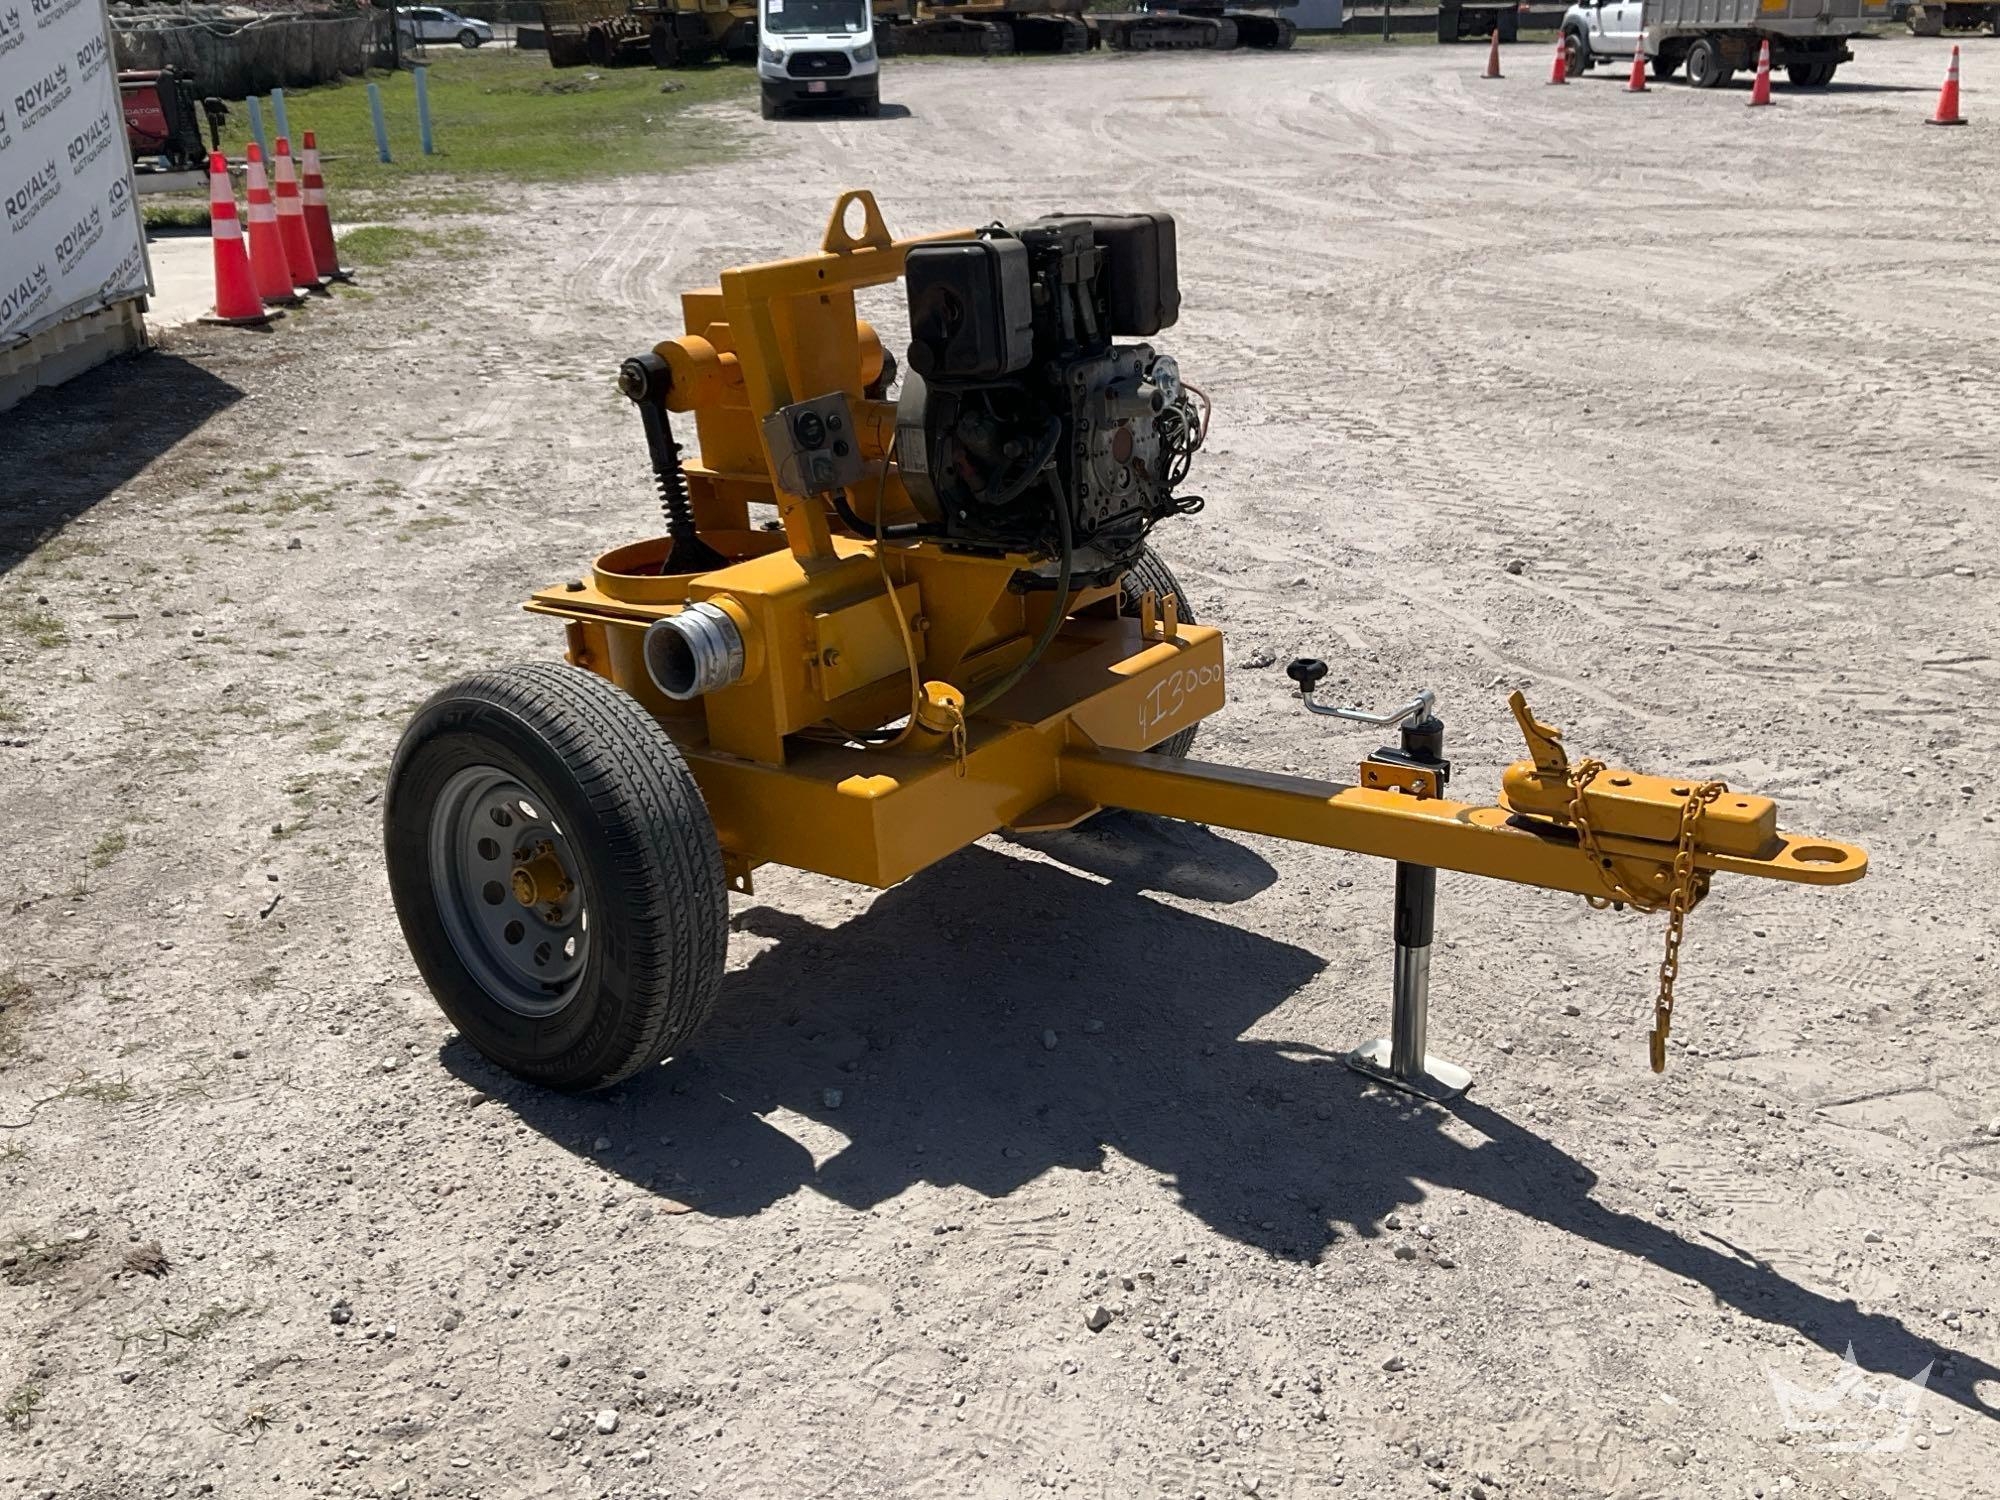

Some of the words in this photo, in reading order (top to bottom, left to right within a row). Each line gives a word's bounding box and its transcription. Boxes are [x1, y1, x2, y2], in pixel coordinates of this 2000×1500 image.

[15, 73, 57, 116] ROYAL
[22, 103, 51, 131] AUCTION
[68, 120, 102, 162] ROYAL
[5, 171, 47, 219] ROYAL
[12, 201, 40, 233] AUCTION
[39, 182, 61, 208] GROUP
[55, 216, 92, 263] ROYAL
[61, 247, 86, 277] AUCTION
[0, 276, 37, 324] OYAL
